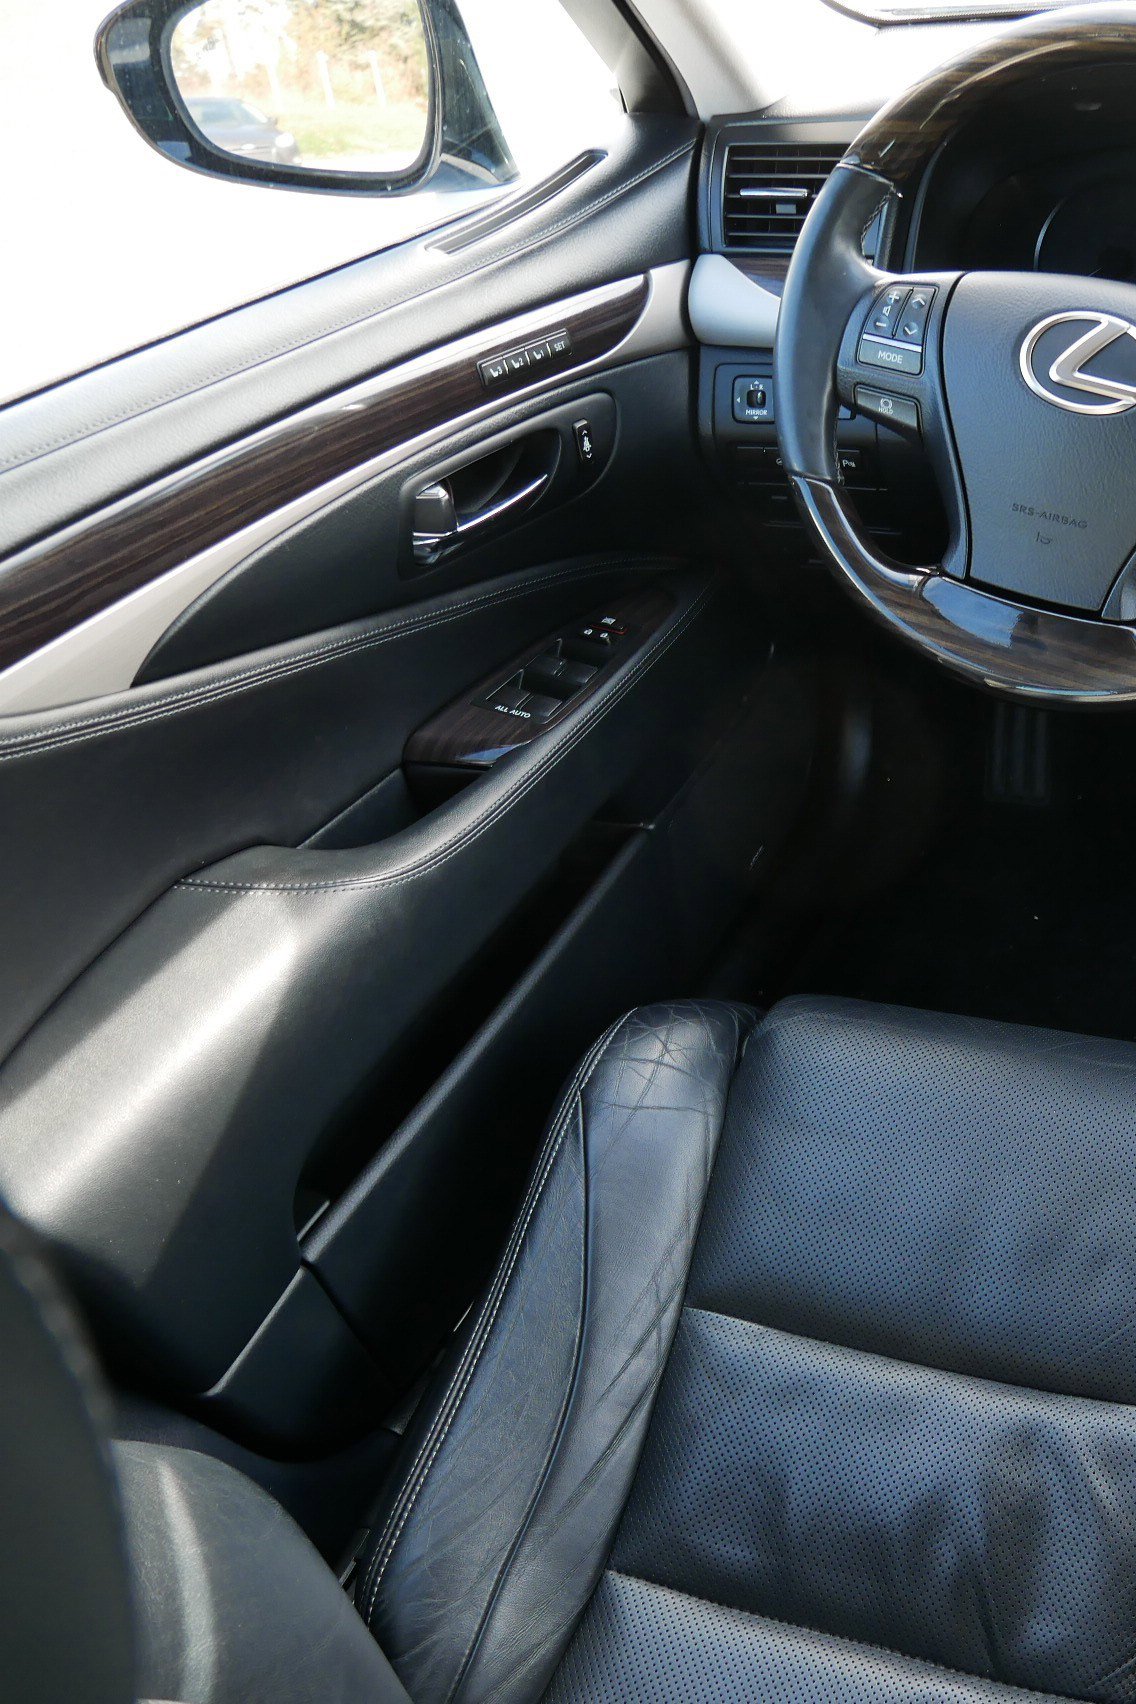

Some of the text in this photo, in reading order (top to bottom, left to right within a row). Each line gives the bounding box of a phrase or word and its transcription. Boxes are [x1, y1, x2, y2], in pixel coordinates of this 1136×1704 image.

[553, 341, 566, 352] SET
[877, 351, 903, 364] MODE
[494, 704, 531, 719] ALL AUTO
